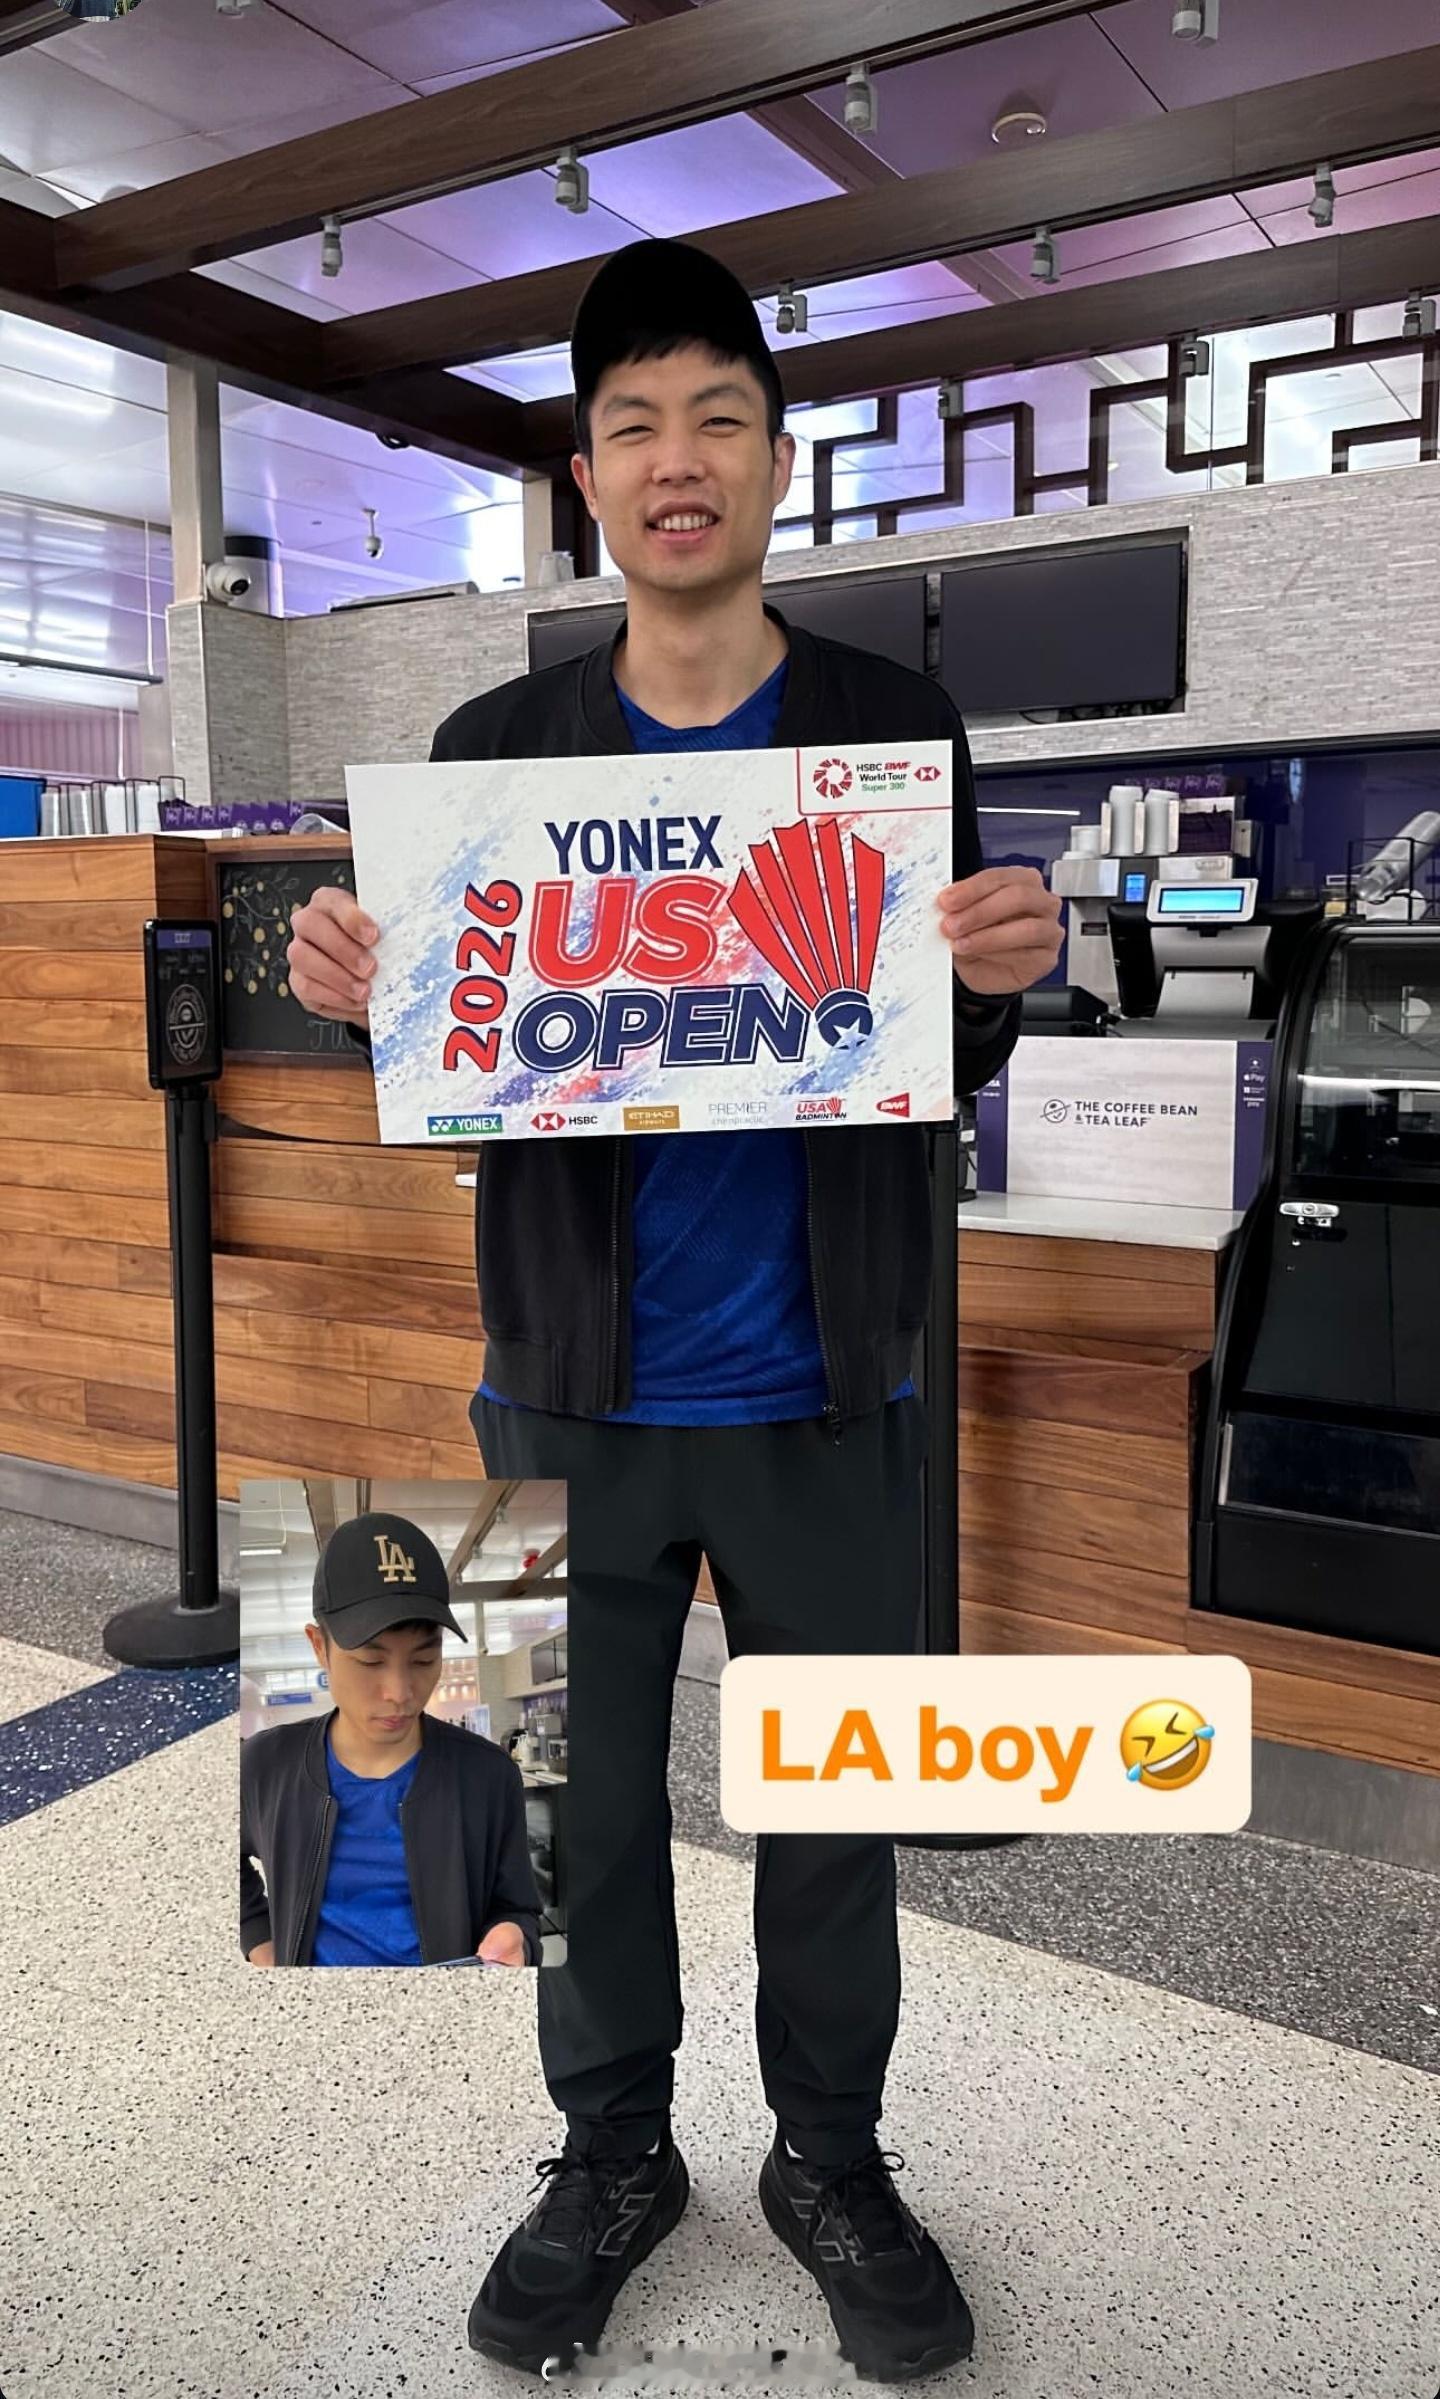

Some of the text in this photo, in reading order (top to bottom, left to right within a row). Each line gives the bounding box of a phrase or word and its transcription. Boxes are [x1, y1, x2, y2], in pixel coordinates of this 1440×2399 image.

[856, 763, 882, 772] HSBC
[860, 772, 907, 782] World Tour
[862, 782, 905, 793] Super 300
[544, 815, 723, 875] YONEX
[528, 875, 728, 989] US
[443, 879, 523, 1073] 2026
[512, 983, 811, 1074] OPEN
[709, 1101, 767, 1115] PREMIER
[796, 1101, 827, 1114] USA
[1075, 1101, 1198, 1116] THE COFFEE BEAN
[456, 1116, 498, 1131] YONEX
[569, 1116, 598, 1126] HSBC
[1086, 1115, 1111, 1126] TEA
[1115, 1116, 1148, 1127] LEAF
[374, 1535, 416, 1582] LA
